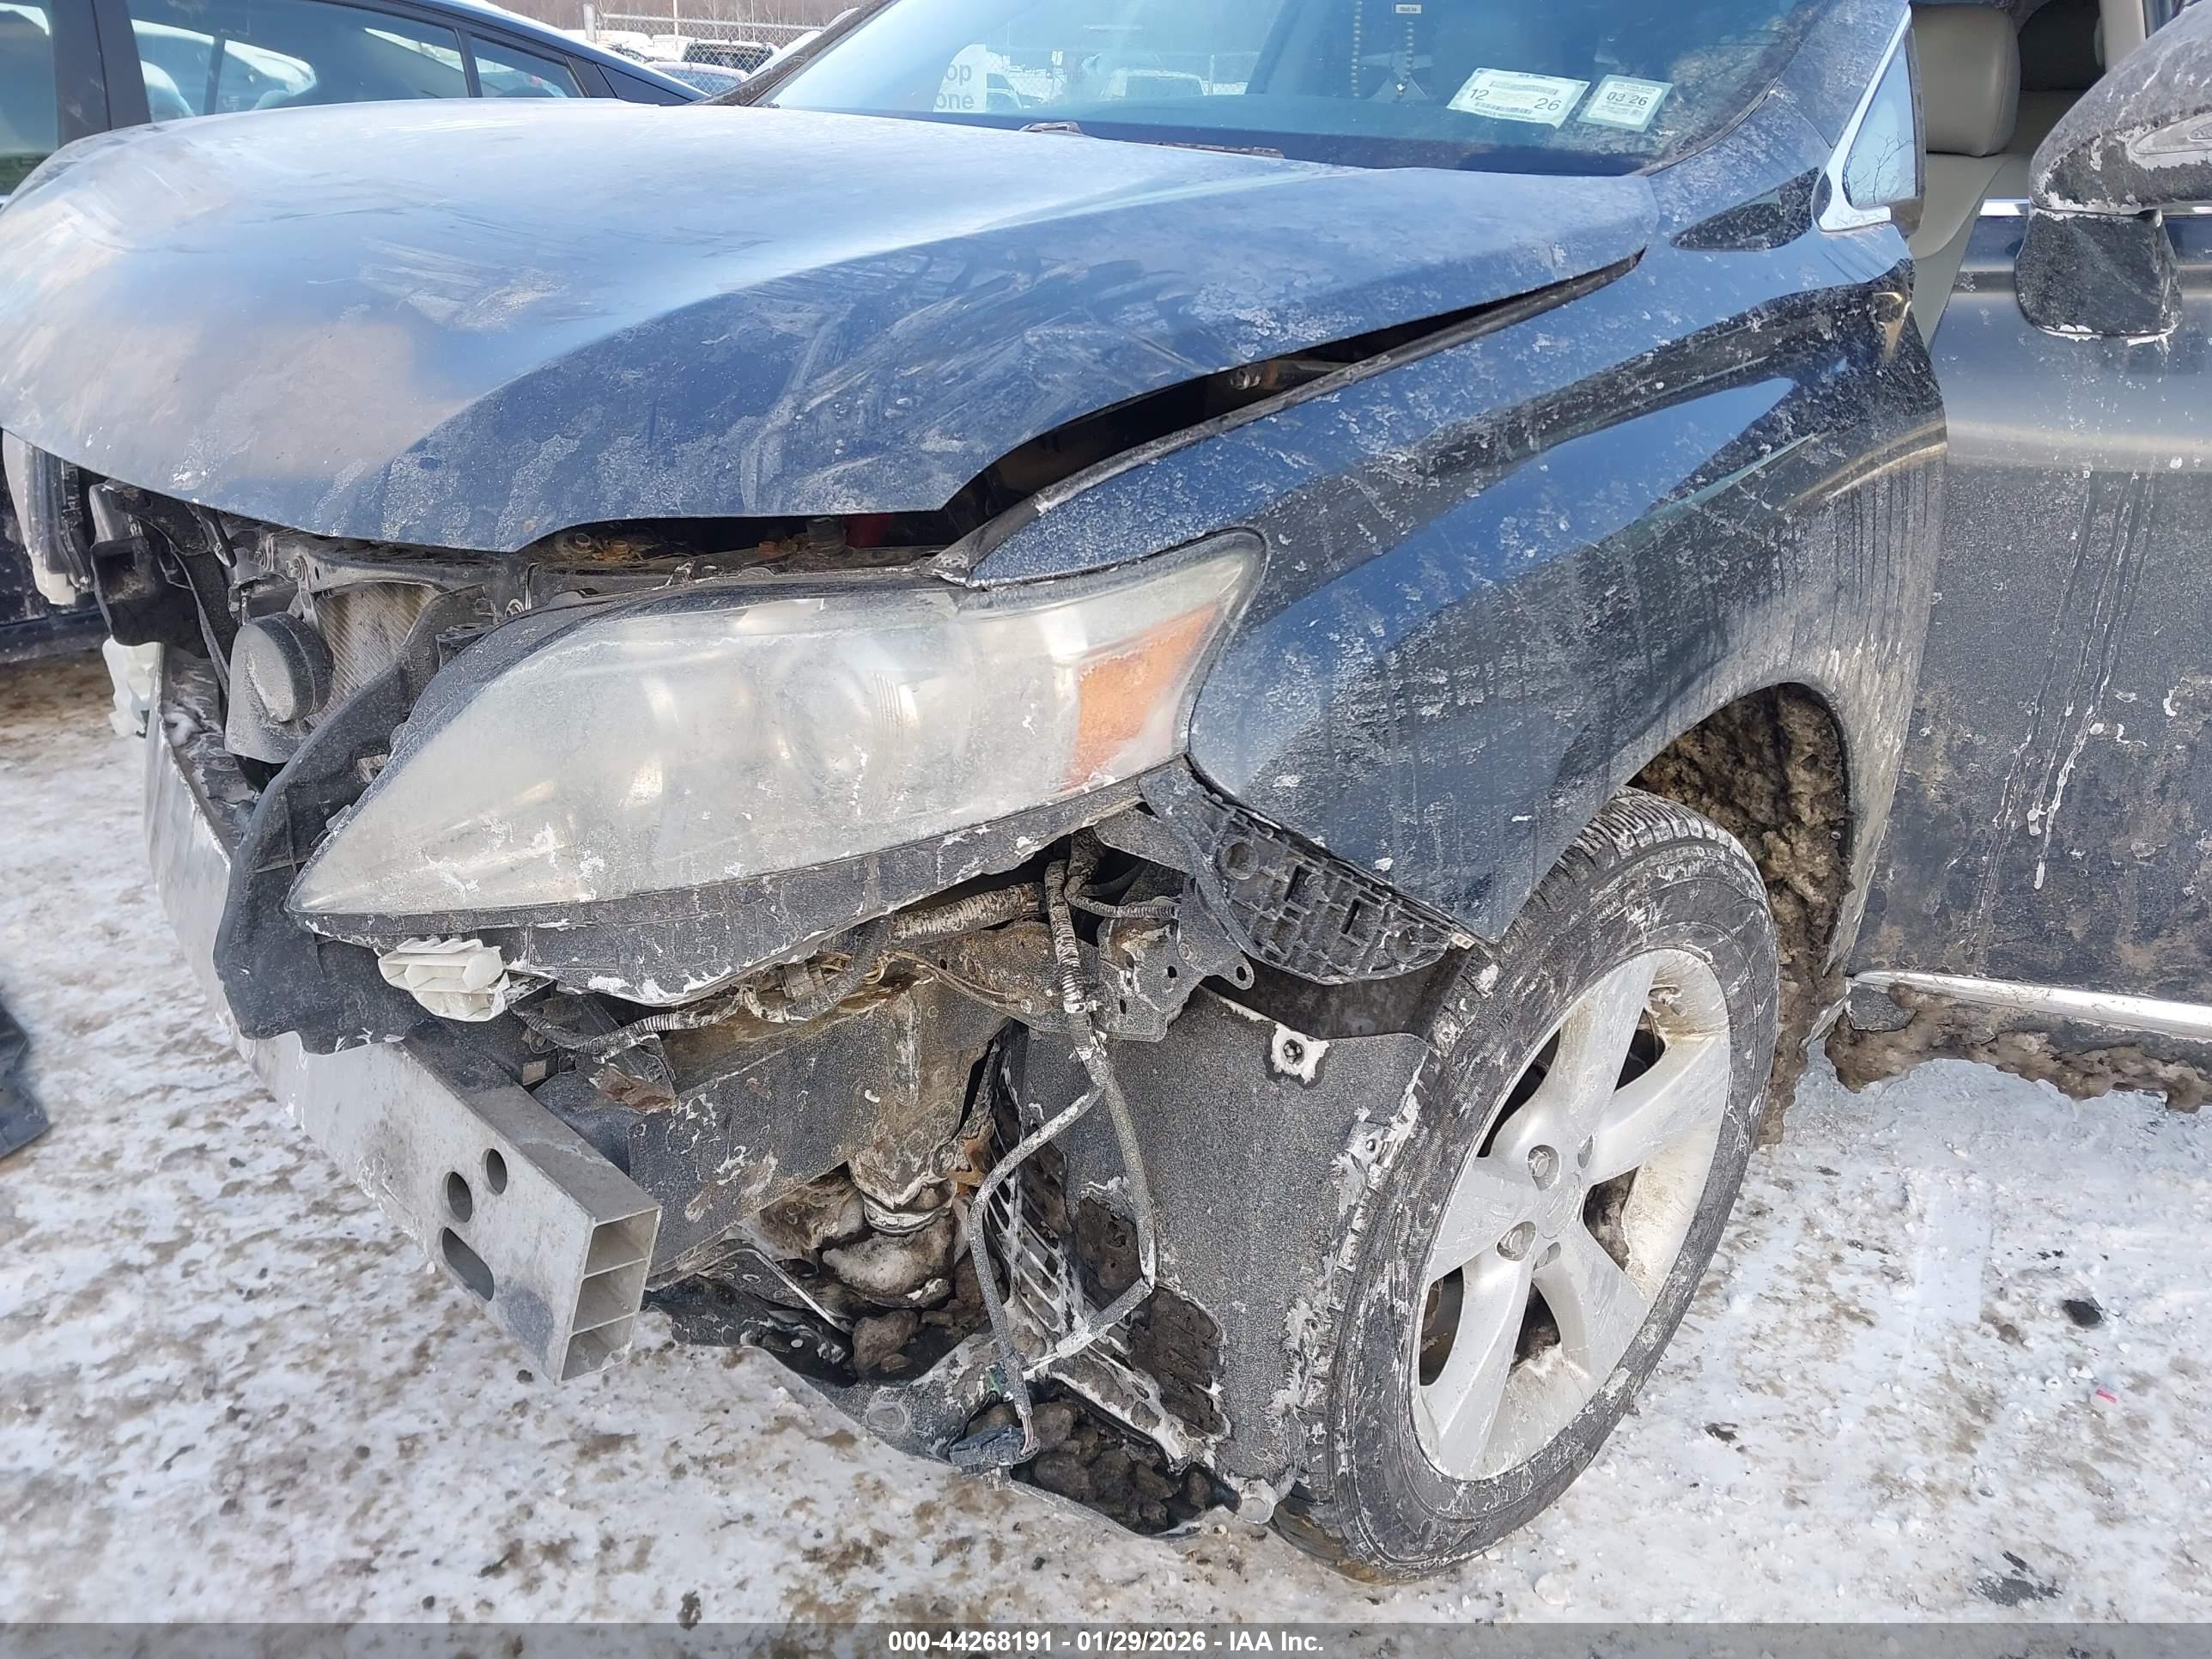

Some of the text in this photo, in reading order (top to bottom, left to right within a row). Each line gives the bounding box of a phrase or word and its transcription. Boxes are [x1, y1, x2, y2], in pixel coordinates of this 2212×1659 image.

[934, 93, 975, 109] one
[1470, 88, 1490, 101] 12
[1607, 91, 1650, 106] 03 26
[1534, 97, 1562, 111] 26
